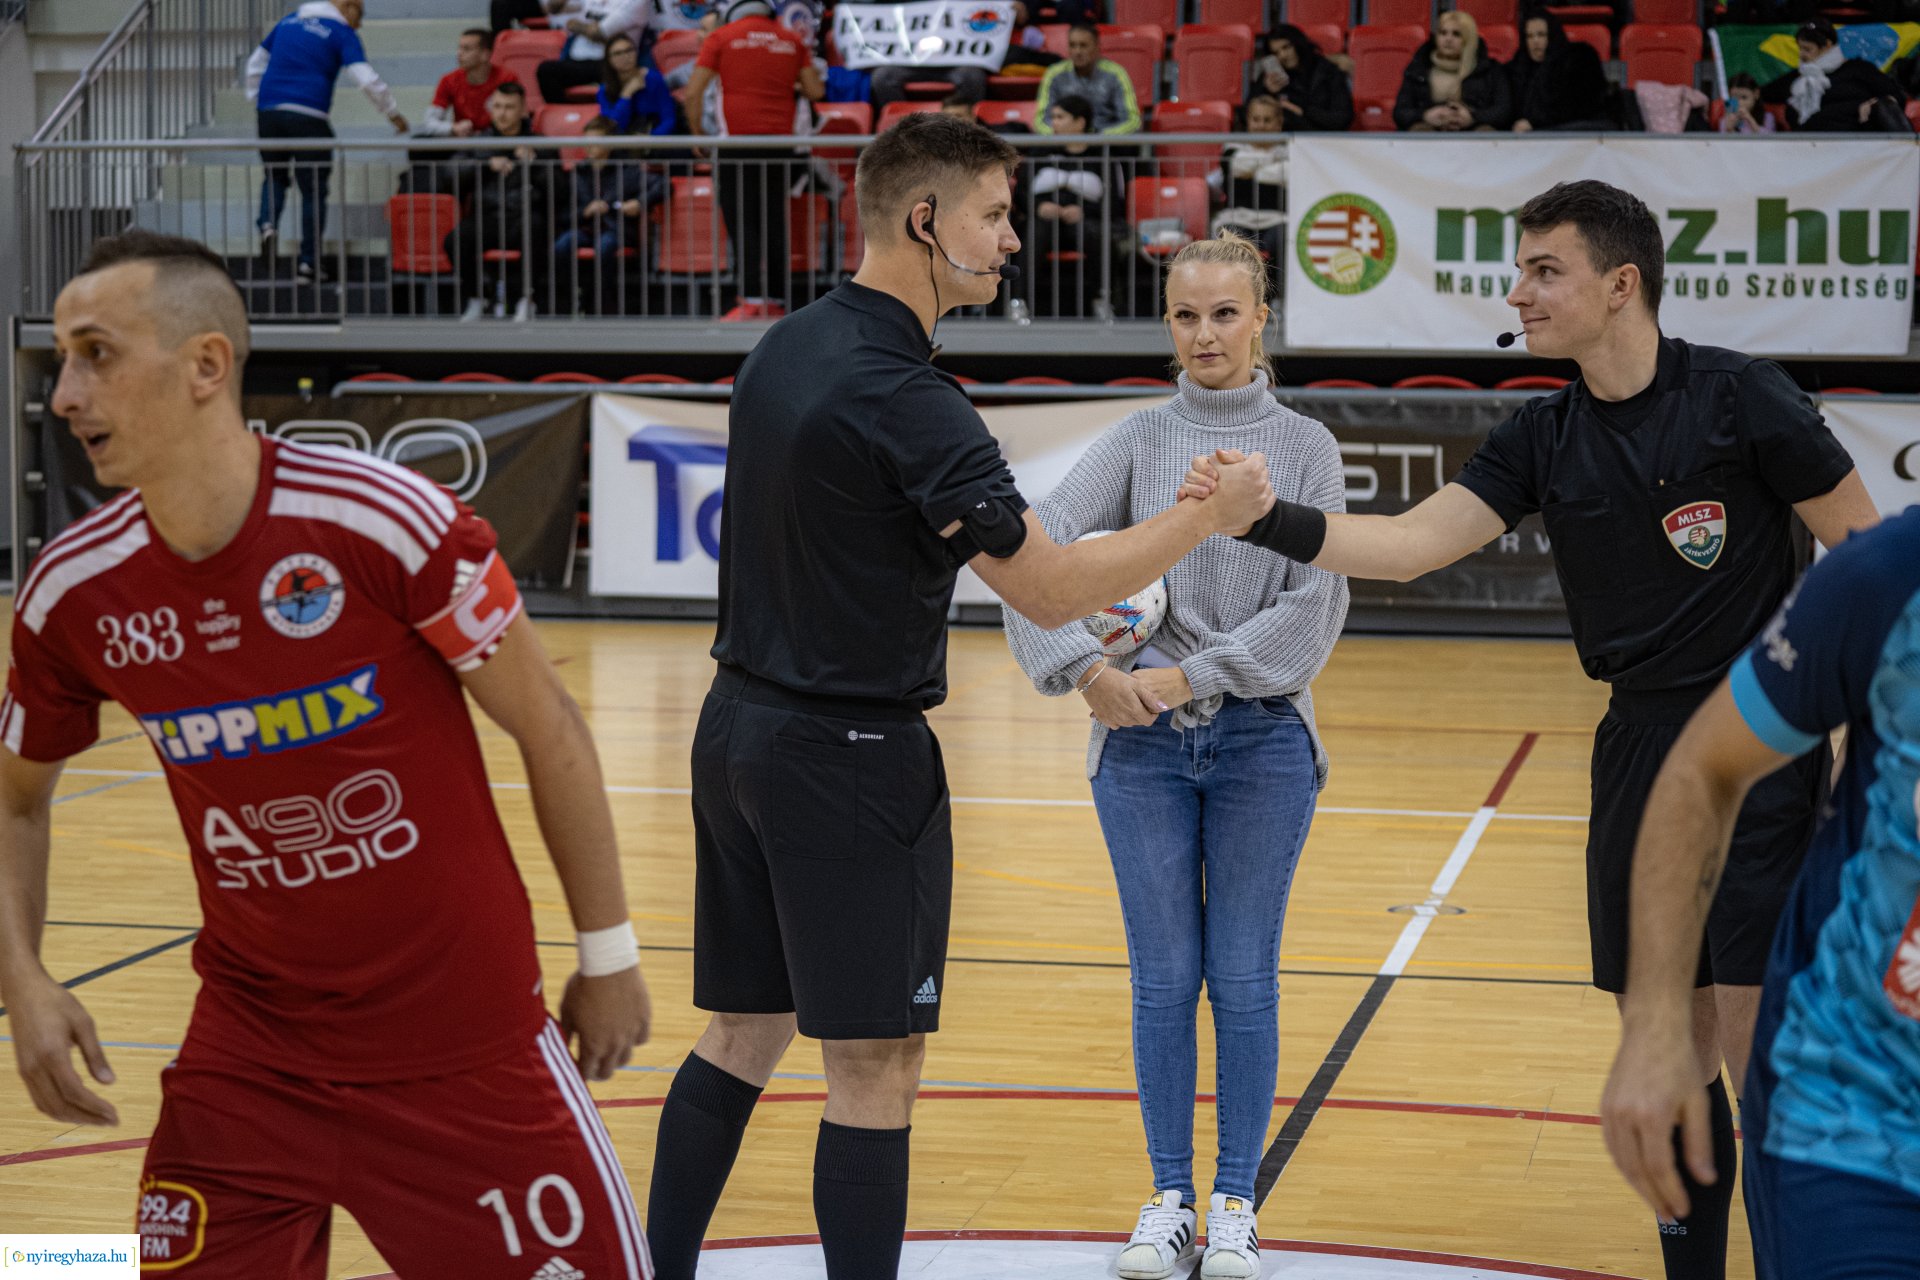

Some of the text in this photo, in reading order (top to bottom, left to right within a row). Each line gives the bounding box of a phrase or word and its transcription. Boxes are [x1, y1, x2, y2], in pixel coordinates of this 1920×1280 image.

[1435, 197, 1910, 265] mz.hu
[1436, 271, 1512, 298] Magy
[1746, 271, 1909, 300] Szövetség
[1677, 507, 1712, 526] MLSZ
[96, 606, 186, 669] 383
[454, 582, 506, 643] C
[215, 818, 419, 890] STUDIO
[913, 993, 938, 1004] adidas
[477, 1173, 584, 1256] 10
[142, 1237, 171, 1258] FM
